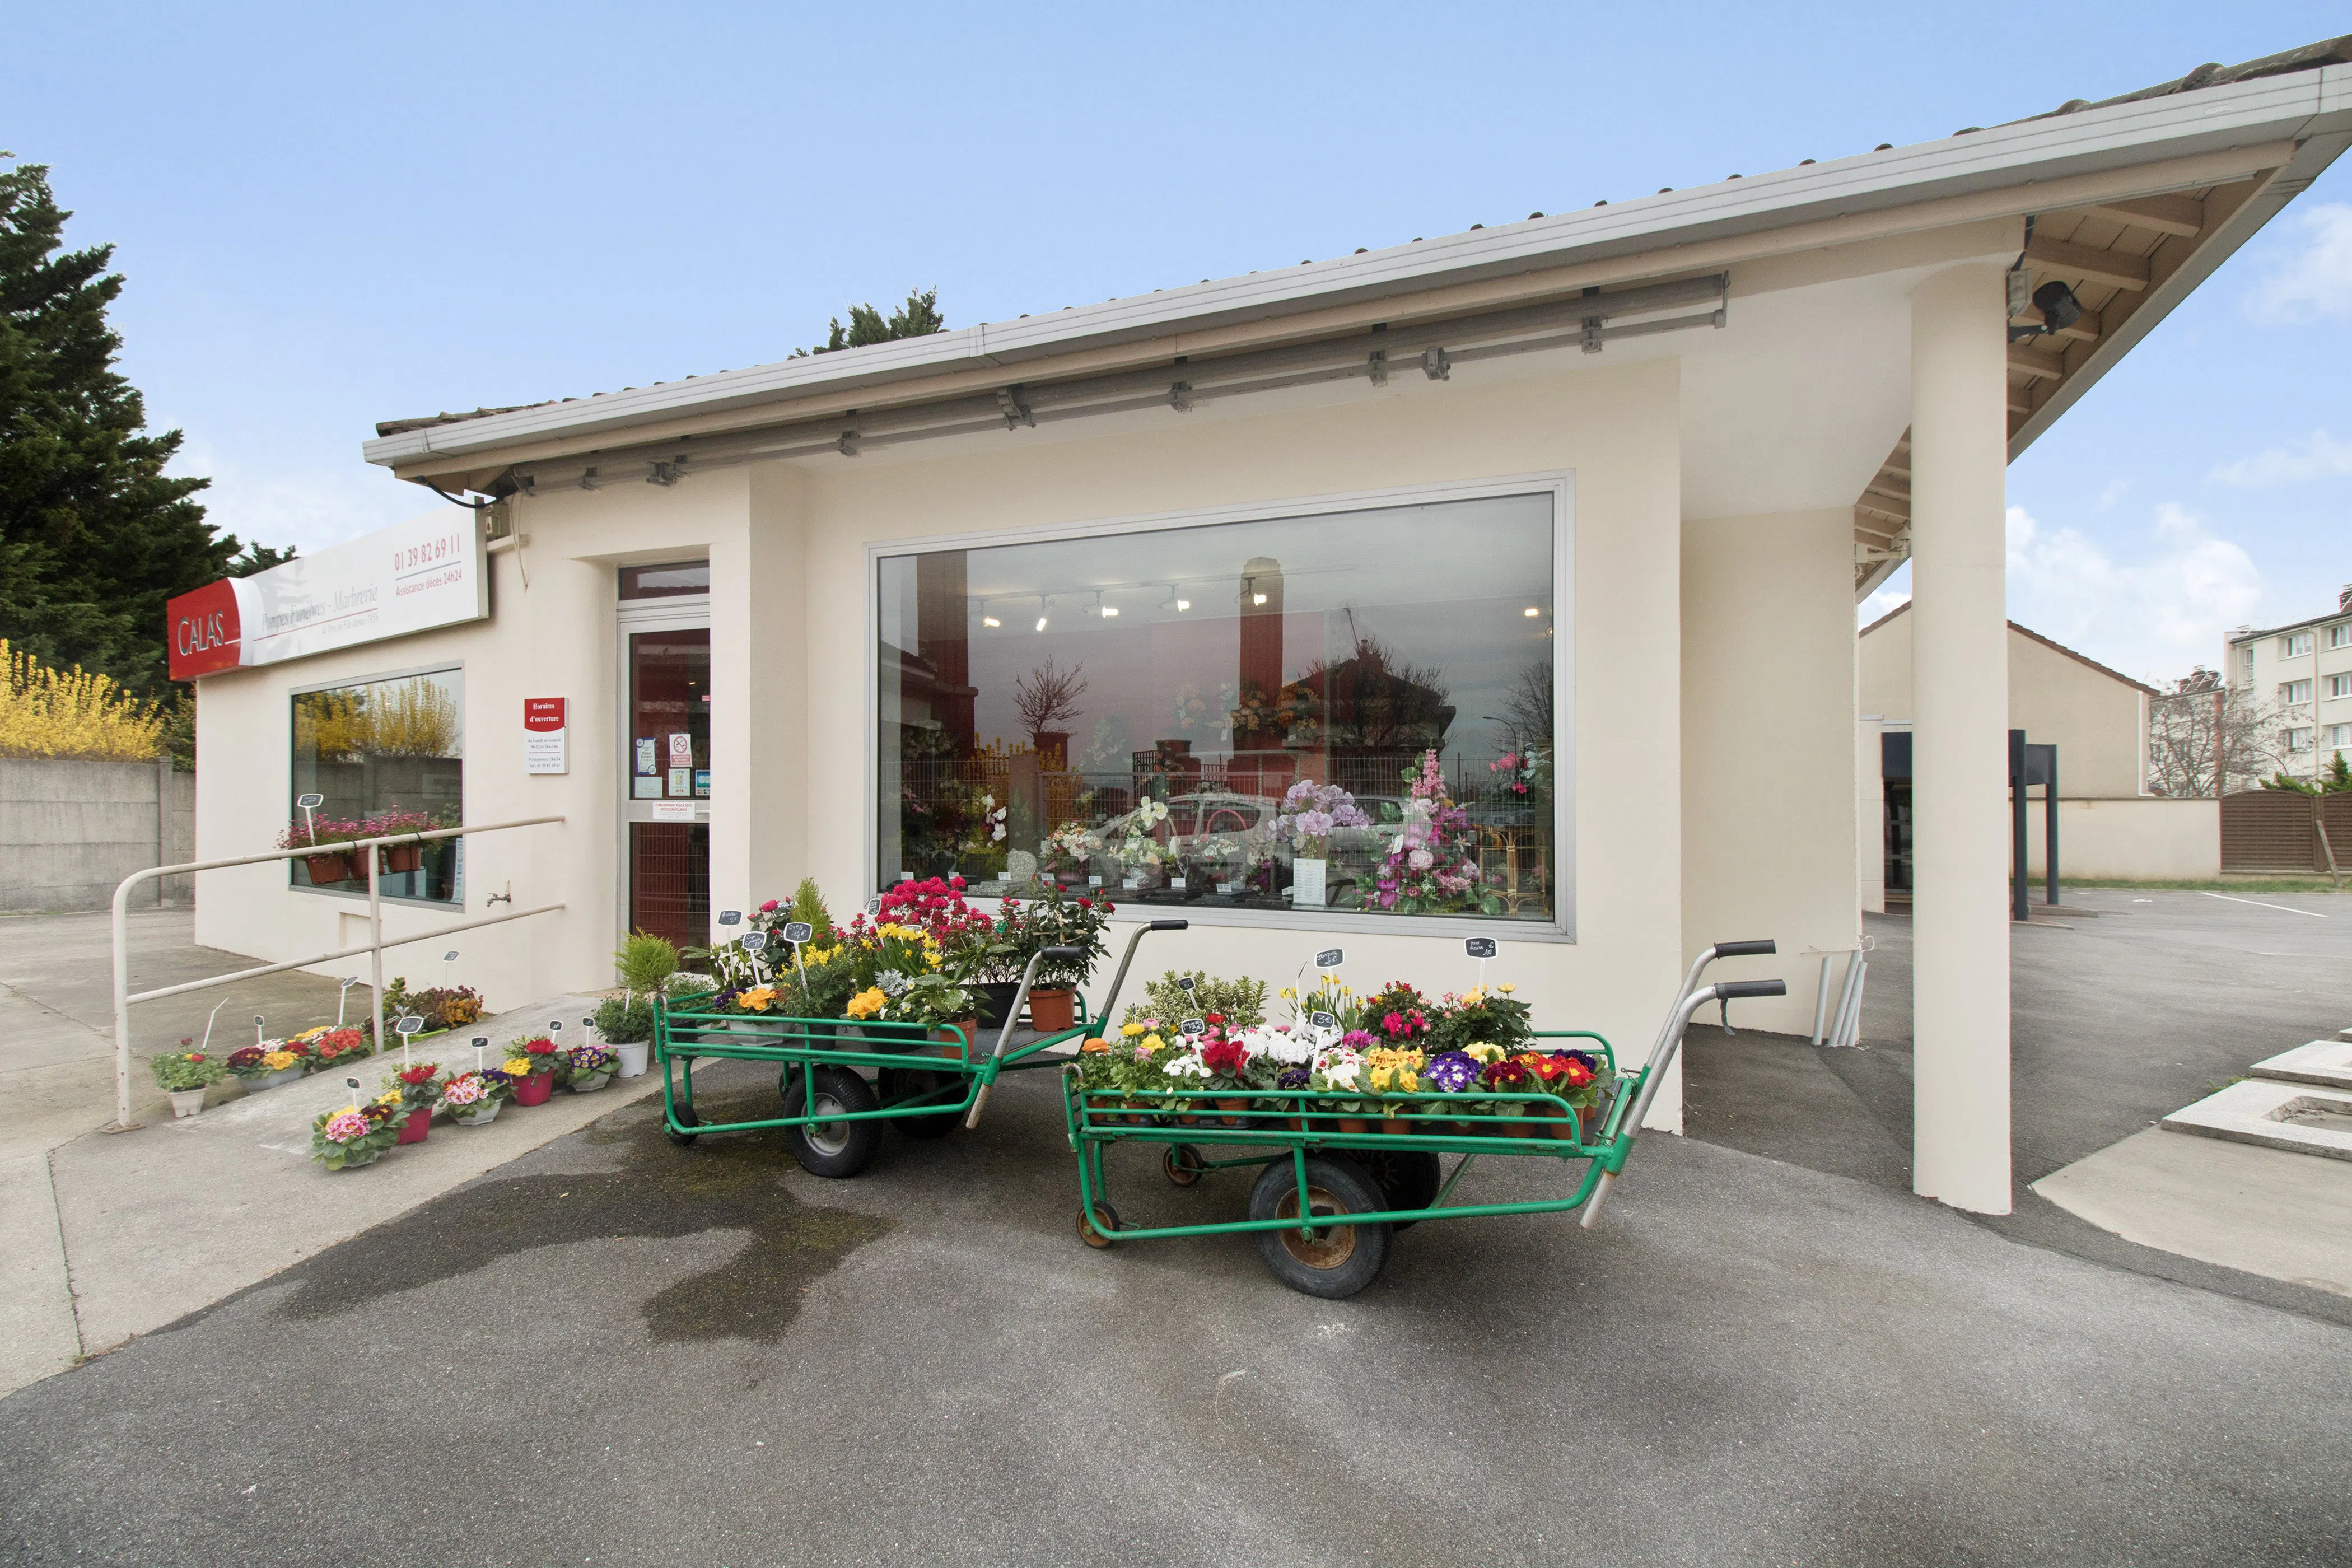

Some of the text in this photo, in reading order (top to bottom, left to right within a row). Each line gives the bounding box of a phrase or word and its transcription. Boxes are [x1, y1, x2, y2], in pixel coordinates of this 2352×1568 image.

[395, 533, 460, 571] 01 39 82 69 11
[395, 568, 462, 598] Assistance décès 24h24
[262, 611, 289, 633] Pompes
[290, 598, 325, 624] Funèbres
[333, 582, 379, 612] Marbrerie
[178, 609, 223, 656] CALAS
[1317, 1015, 1332, 1024] 3€
